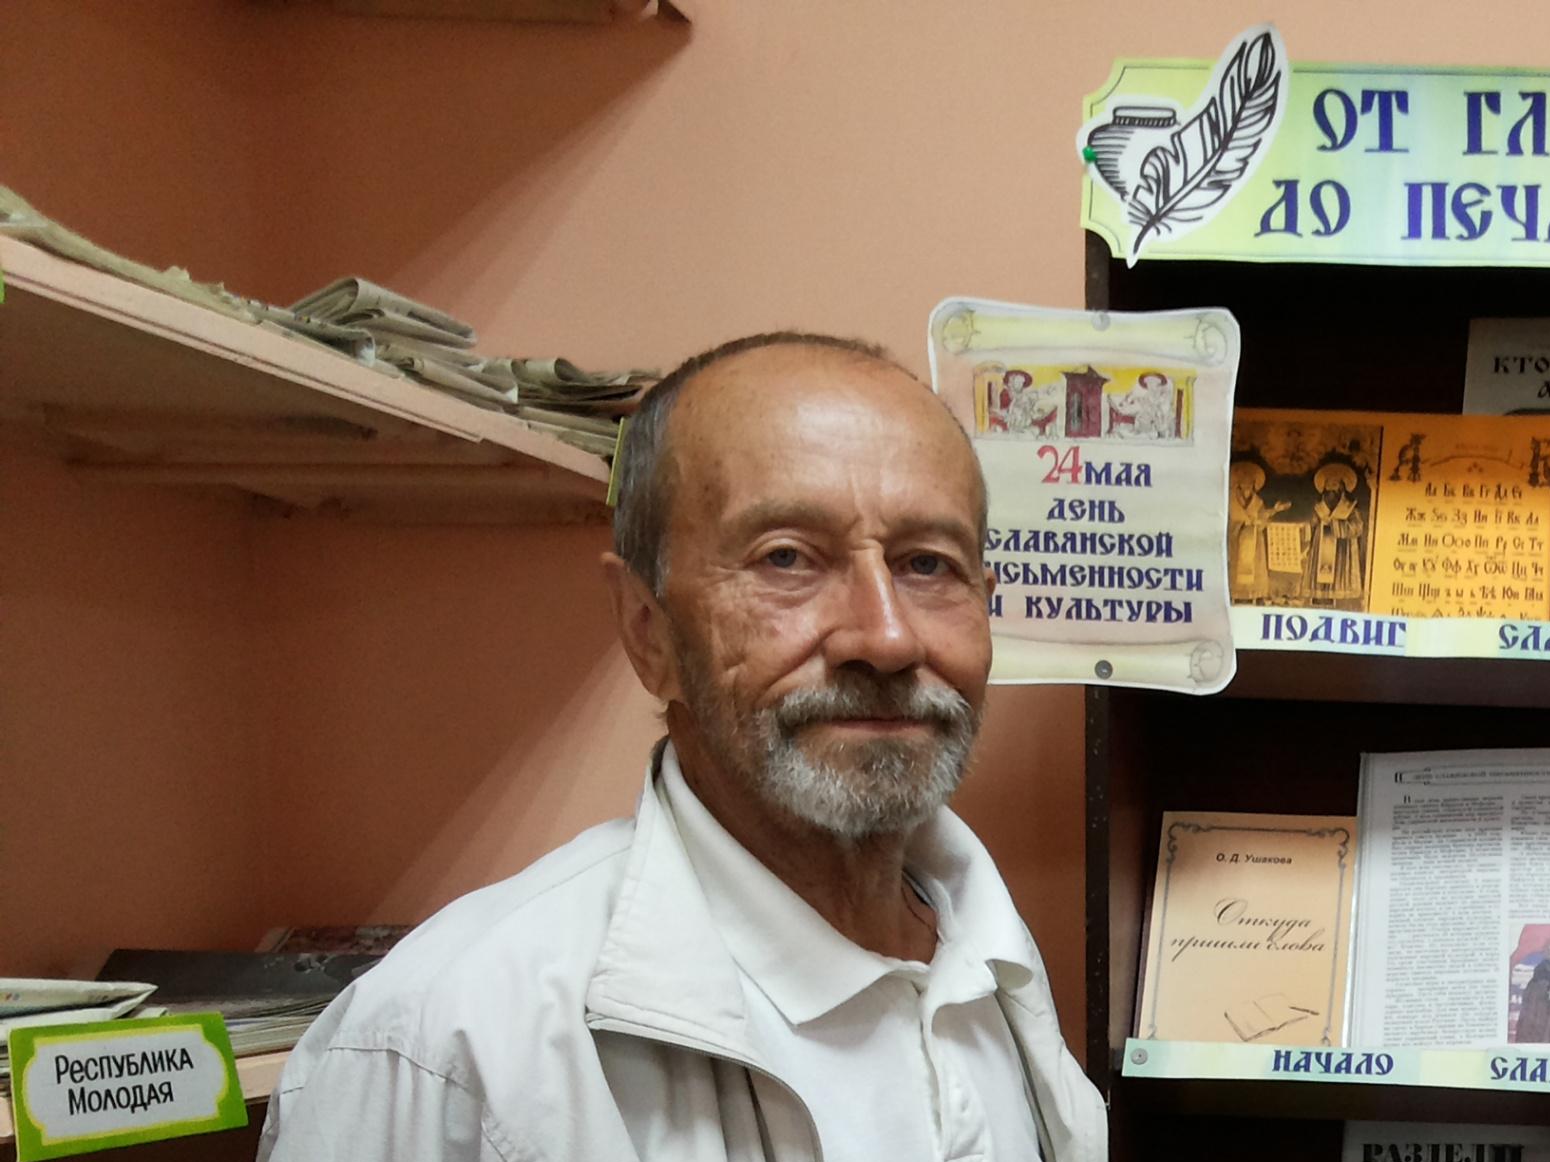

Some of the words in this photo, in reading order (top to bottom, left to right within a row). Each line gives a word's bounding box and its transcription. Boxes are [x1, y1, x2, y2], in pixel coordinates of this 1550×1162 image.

[1312, 88, 1409, 153] ОТ
[1254, 179, 1351, 238] ДО
[1493, 354, 1550, 375] КТО
[1036, 446, 1082, 484] 24
[1084, 461, 1153, 488] МАЯ
[1046, 498, 1126, 523] ДЕНЬ
[984, 528, 1174, 558] СЛАВЯНСКОЙ
[984, 562, 1204, 592] ИСЬМЕННОСТИ
[1025, 596, 1193, 624] КУЛЬТУРЫ
[1259, 612, 1407, 647] ПОДВИГ
[1245, 855, 1293, 866] Ушакова
[1213, 898, 1312, 941] Откуда
[1170, 936, 1262, 962] пришли
[1271, 1050, 1395, 1076] НАЧАЛО
